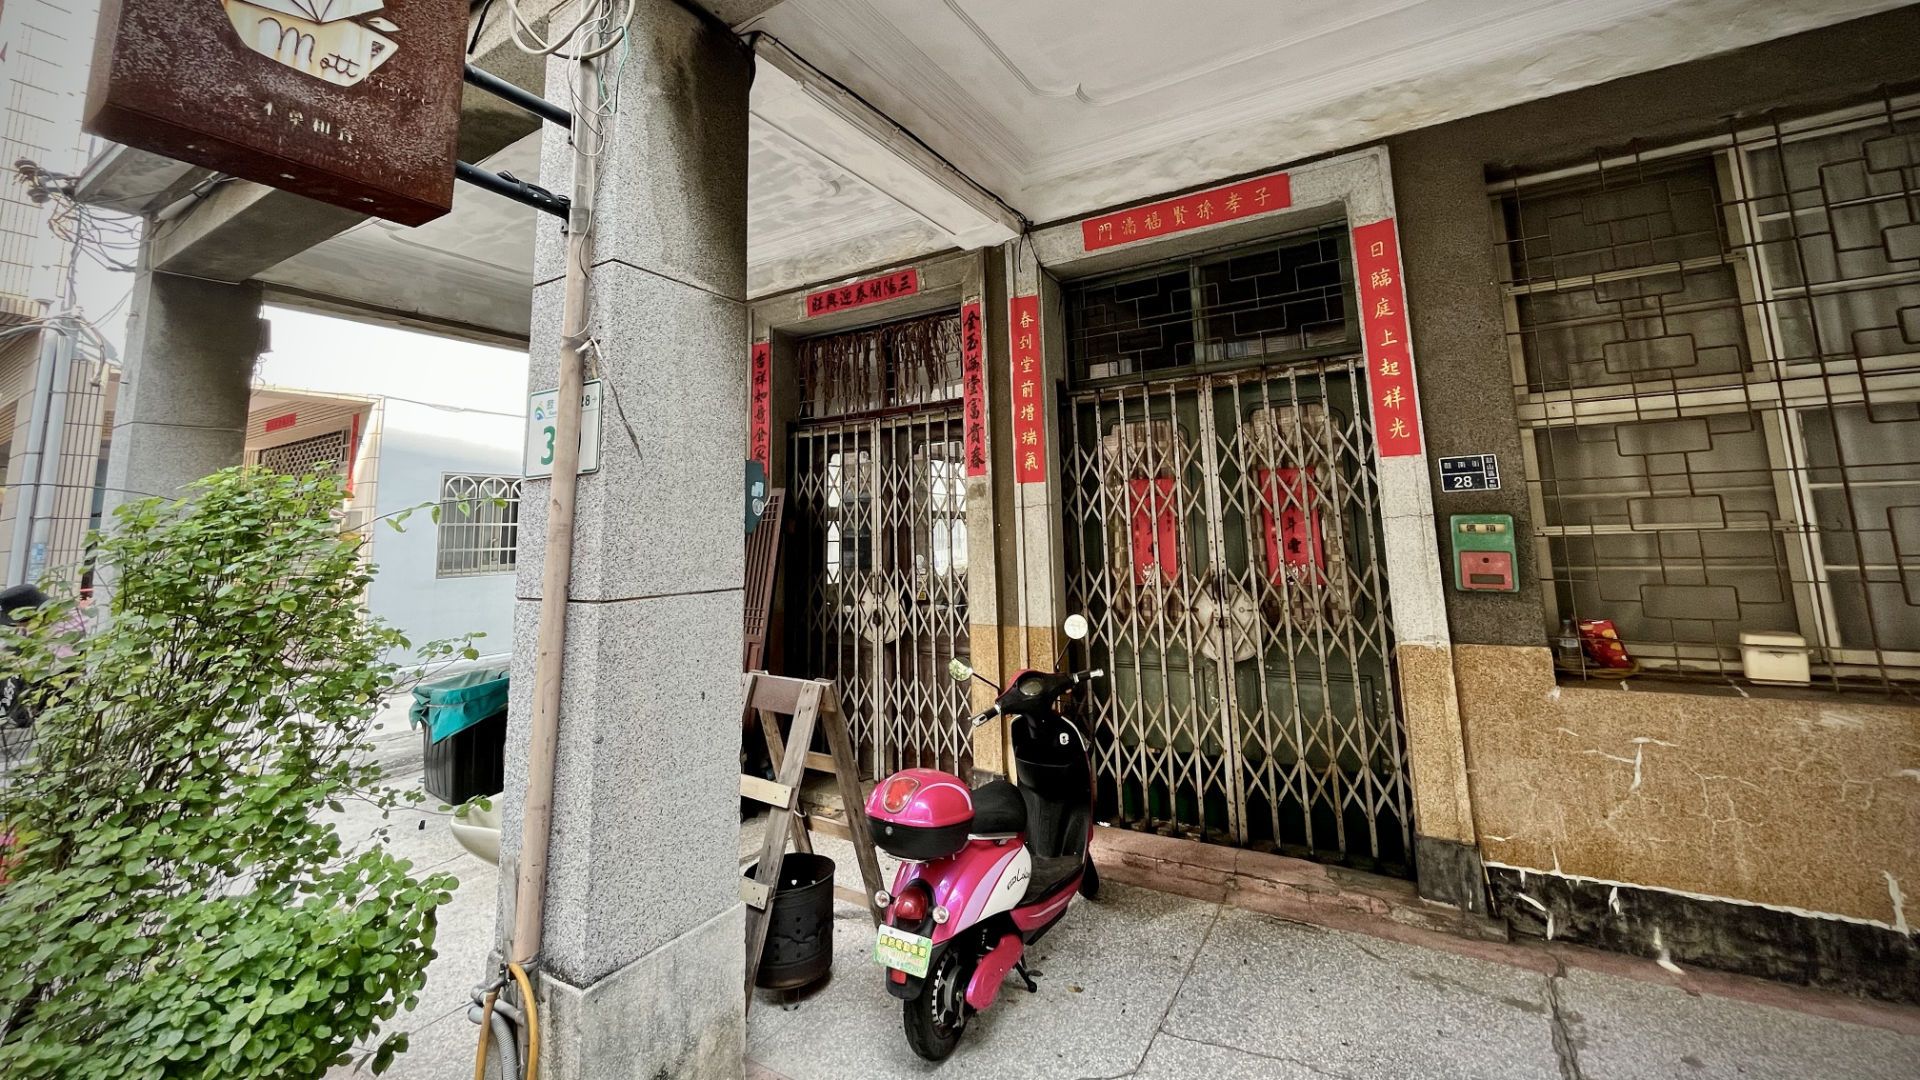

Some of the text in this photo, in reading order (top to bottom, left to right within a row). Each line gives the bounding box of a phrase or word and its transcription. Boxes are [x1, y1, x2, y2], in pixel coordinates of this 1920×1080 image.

[1019, 310, 1039, 471] 春到堂前增瑞氣
[1370, 241, 1410, 439] 日臨庭上起祥光
[753, 350, 768, 474] 吉祥如意全家
[1453, 475, 1473, 488] 28
